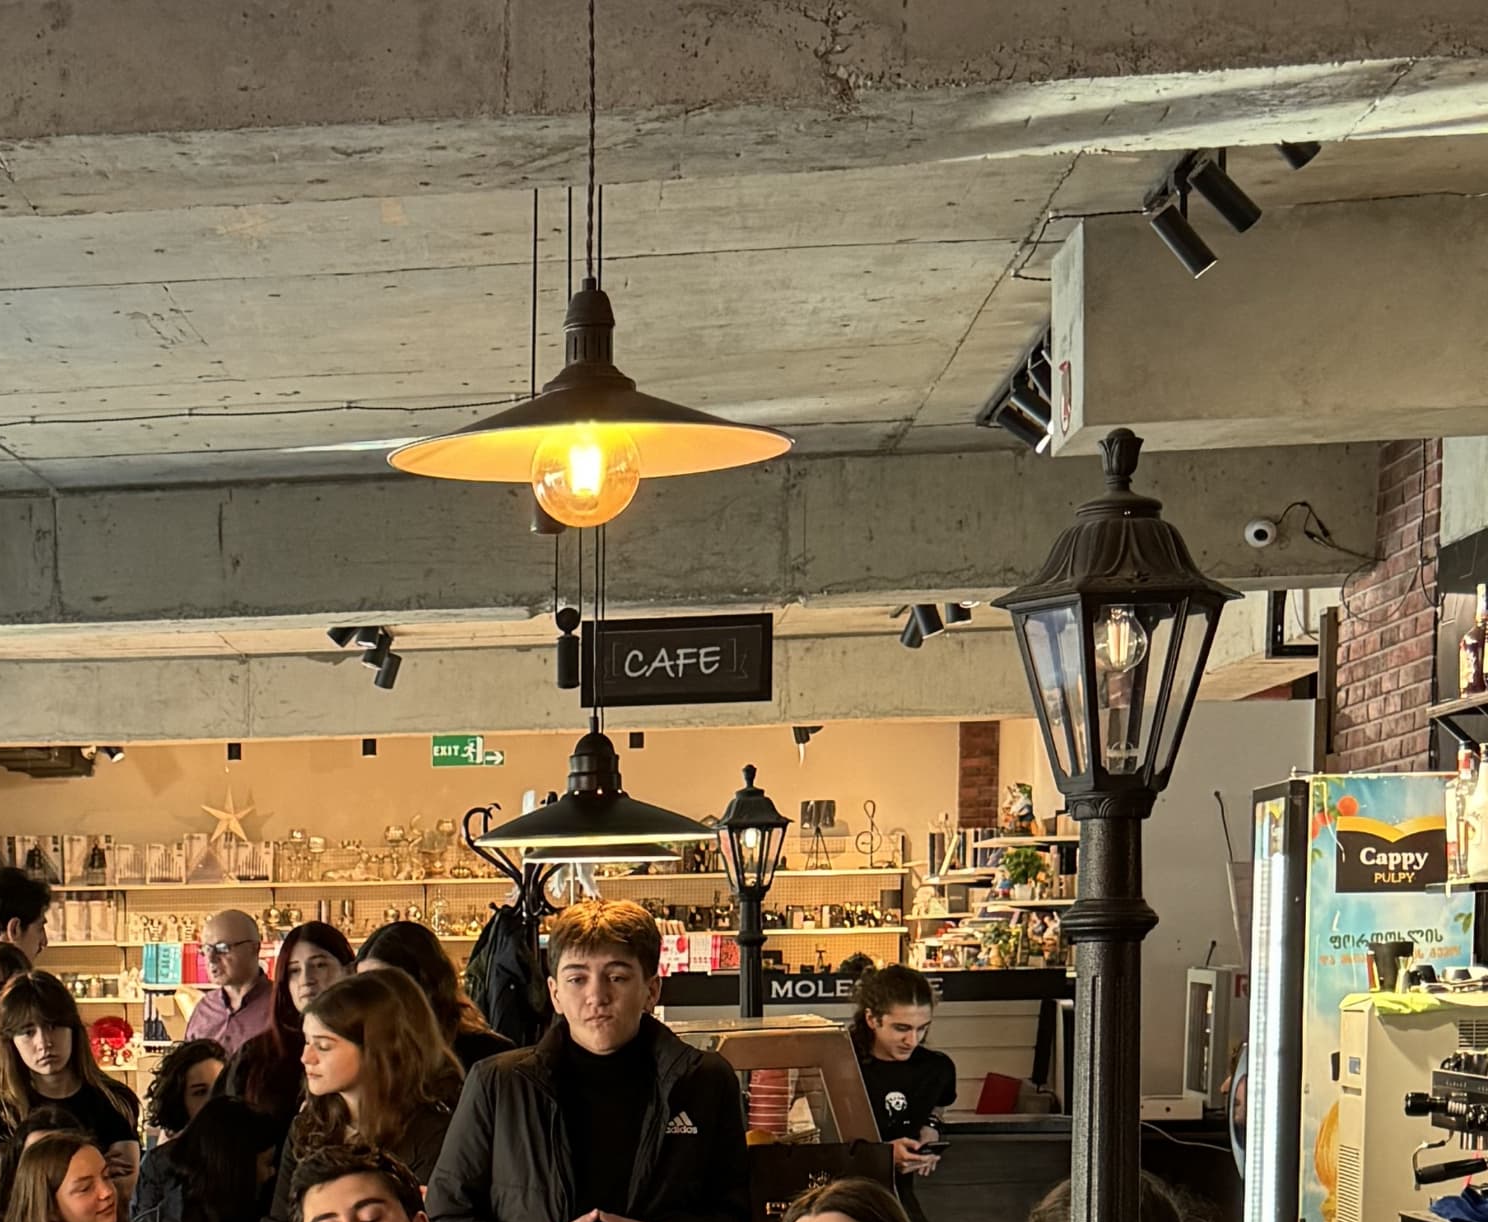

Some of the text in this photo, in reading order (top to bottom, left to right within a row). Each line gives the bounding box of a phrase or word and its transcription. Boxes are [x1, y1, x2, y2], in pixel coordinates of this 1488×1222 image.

[624, 646, 721, 678] CAFE
[433, 745, 460, 756] EXIT
[1359, 846, 1429, 870] Cappy
[1373, 872, 1416, 883] PULPY
[770, 978, 944, 998] MOLEE
